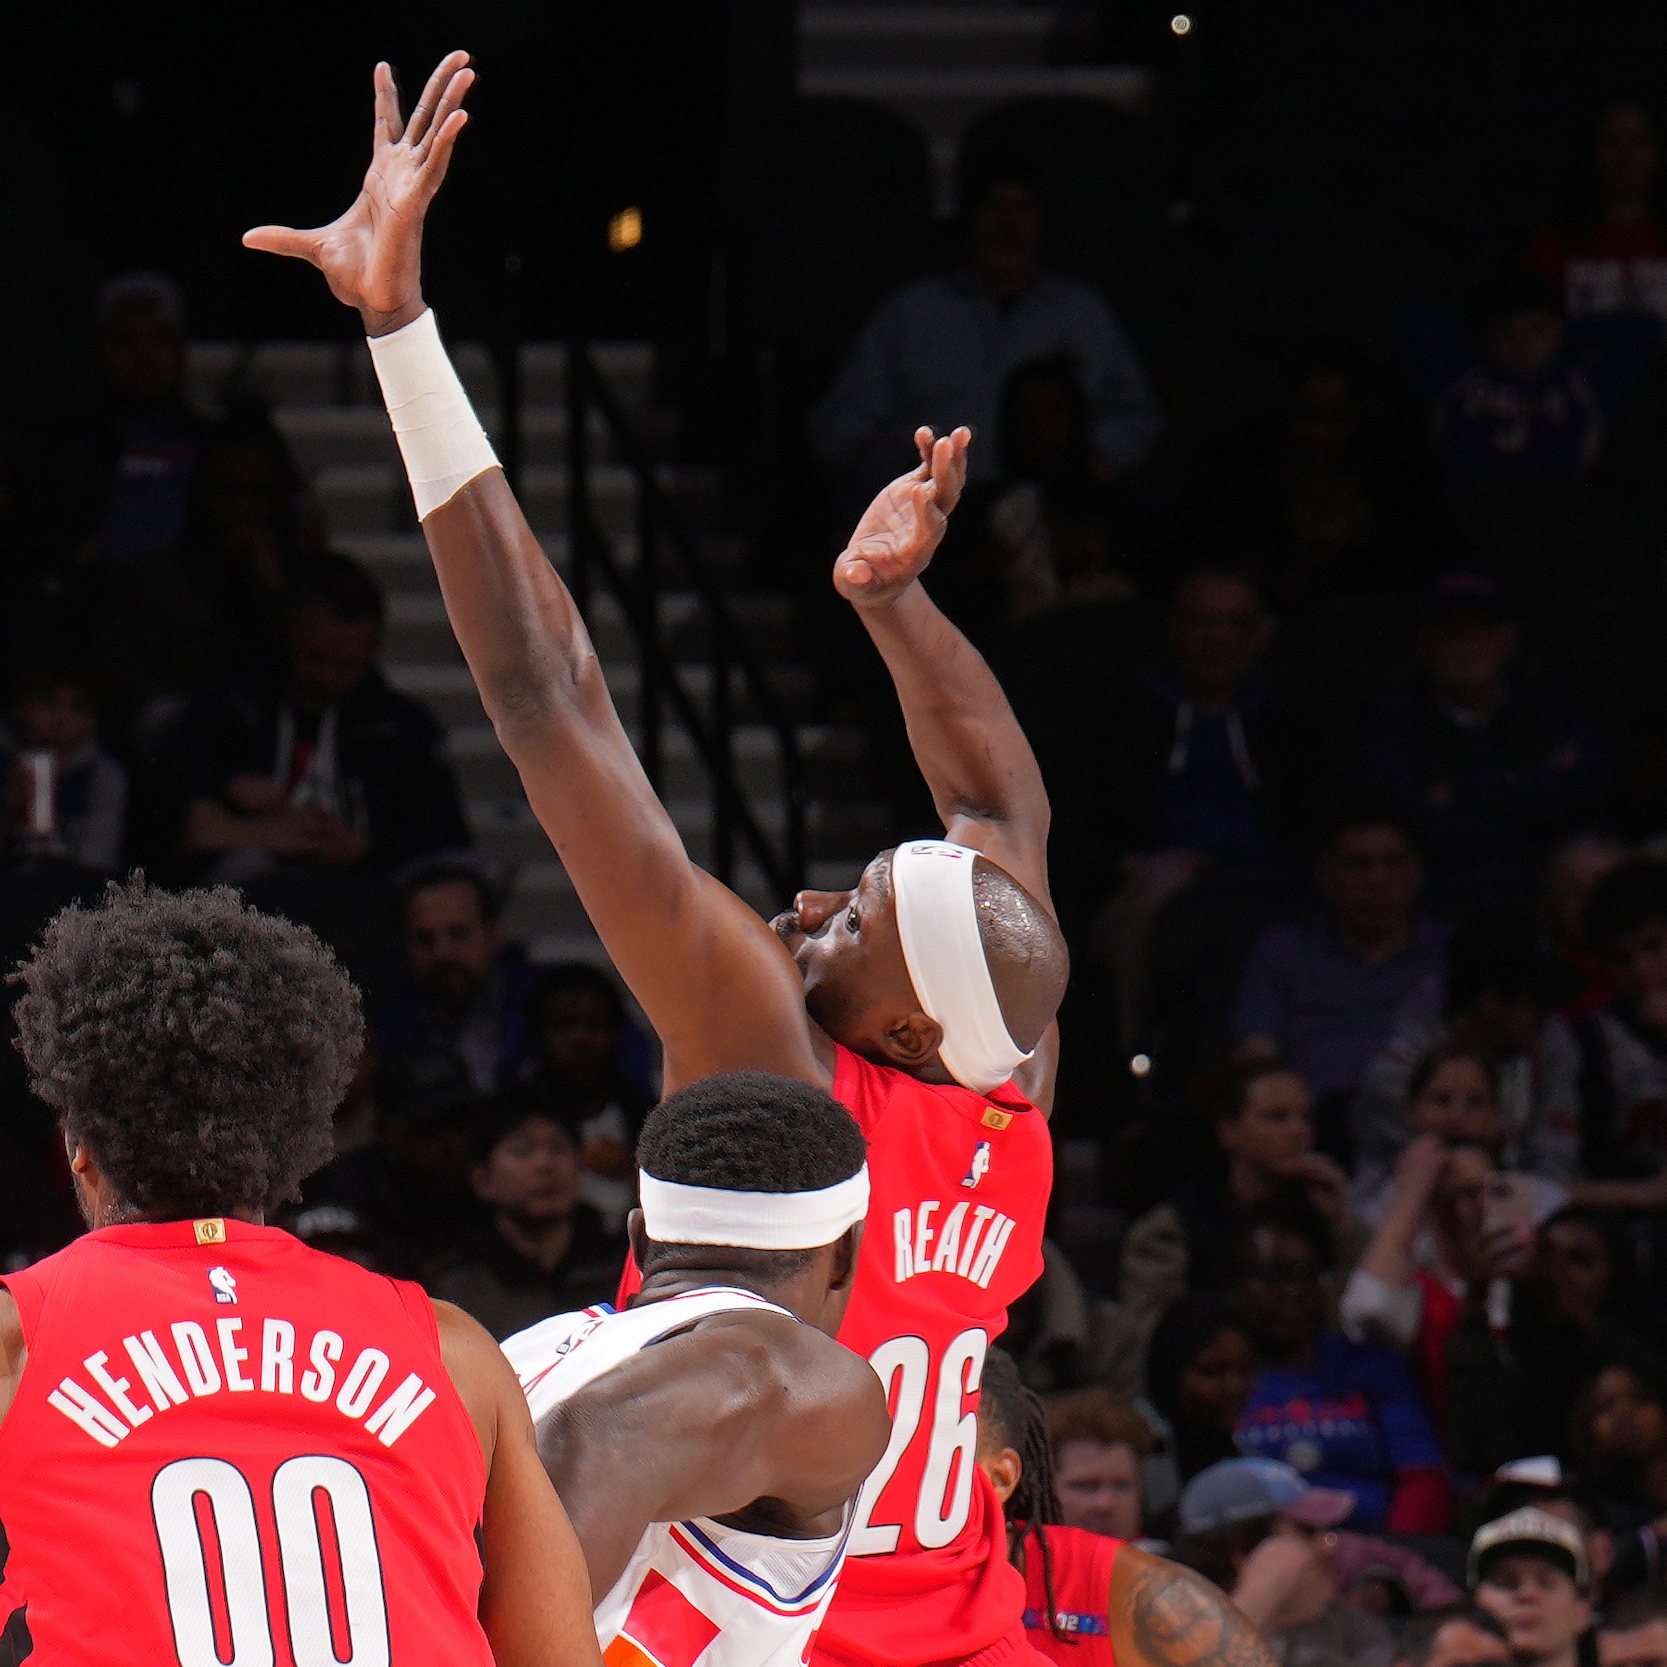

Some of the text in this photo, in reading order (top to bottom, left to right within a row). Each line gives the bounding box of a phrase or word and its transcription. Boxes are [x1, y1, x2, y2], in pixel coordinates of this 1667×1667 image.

[892, 1200, 1016, 1289] REATH
[47, 1317, 436, 1448] HENDERSON
[847, 1328, 987, 1556] 26
